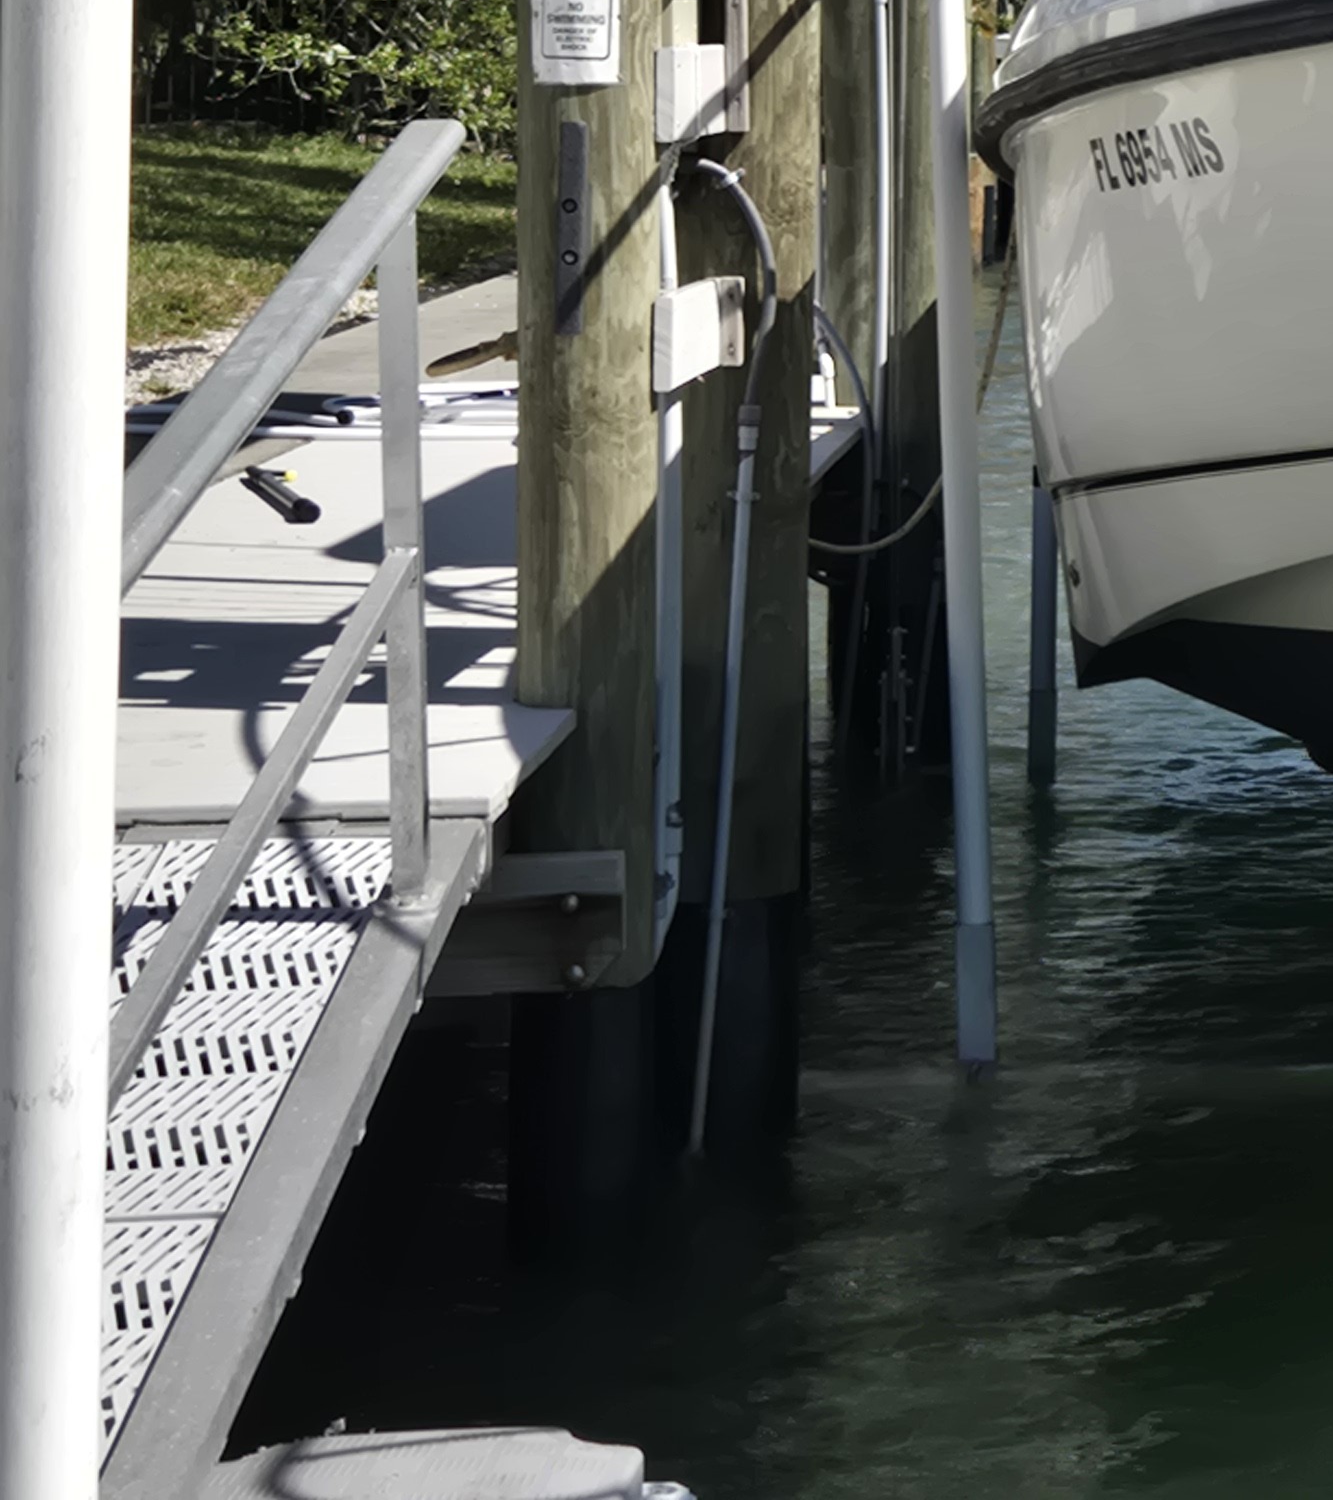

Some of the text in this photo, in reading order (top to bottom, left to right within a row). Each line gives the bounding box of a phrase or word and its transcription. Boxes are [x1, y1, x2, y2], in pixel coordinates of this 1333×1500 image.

[567, 2, 583, 12] NO
[547, 13, 605, 25] SMNG
[1089, 117, 1224, 192] FL 6954 MS
